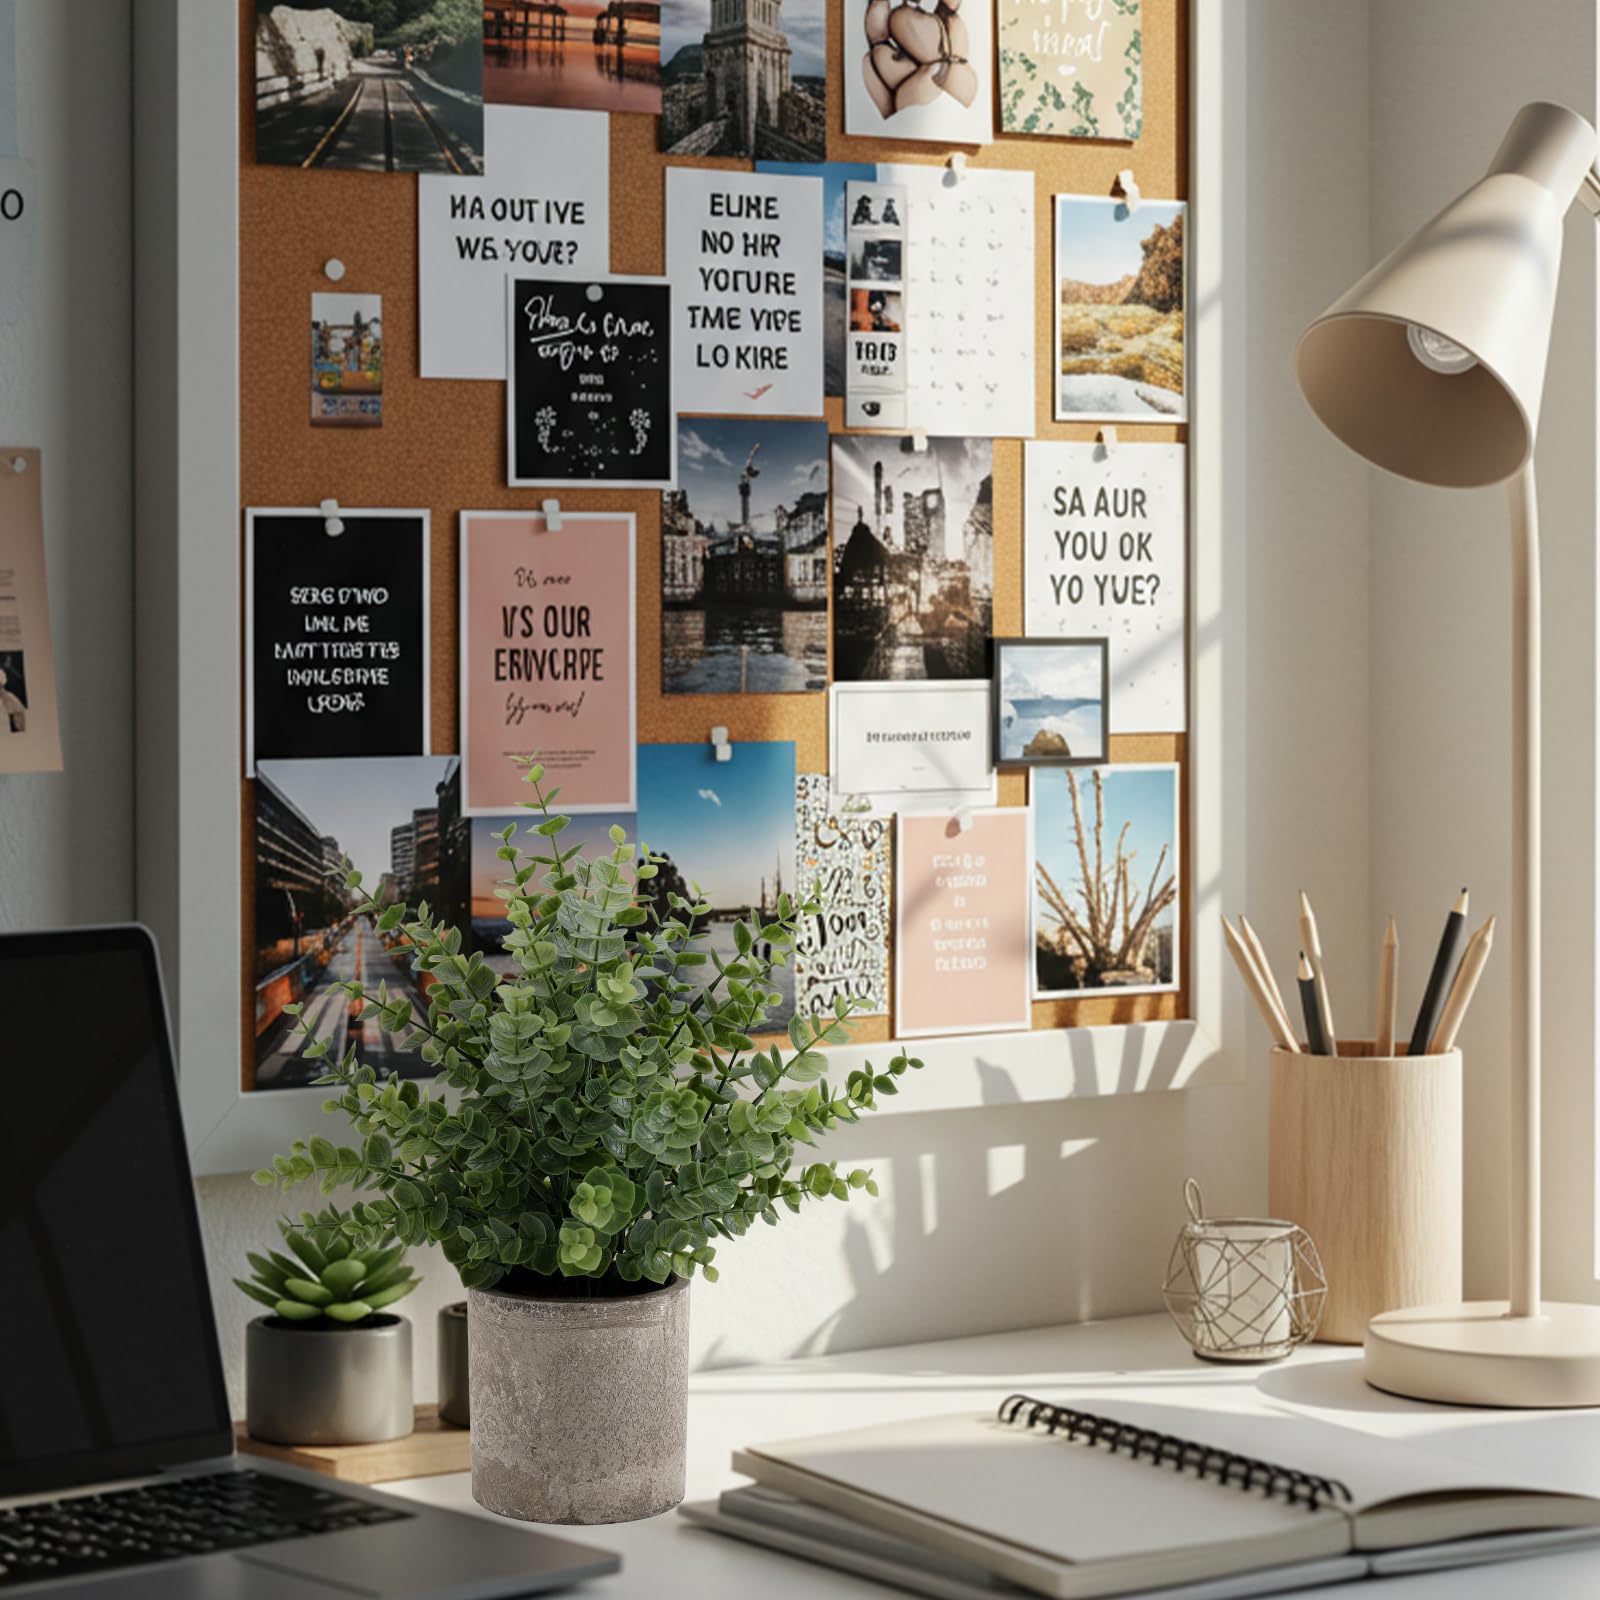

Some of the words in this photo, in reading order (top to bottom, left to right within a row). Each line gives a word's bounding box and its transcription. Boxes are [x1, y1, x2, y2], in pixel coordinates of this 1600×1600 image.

[1053, 486, 1085, 517] SA
[1094, 486, 1147, 518] AUR
[1054, 530, 1107, 561] YOU
[1119, 531, 1153, 562] OK
[1050, 574, 1084, 606] YO
[543, 605, 591, 639] OUR
